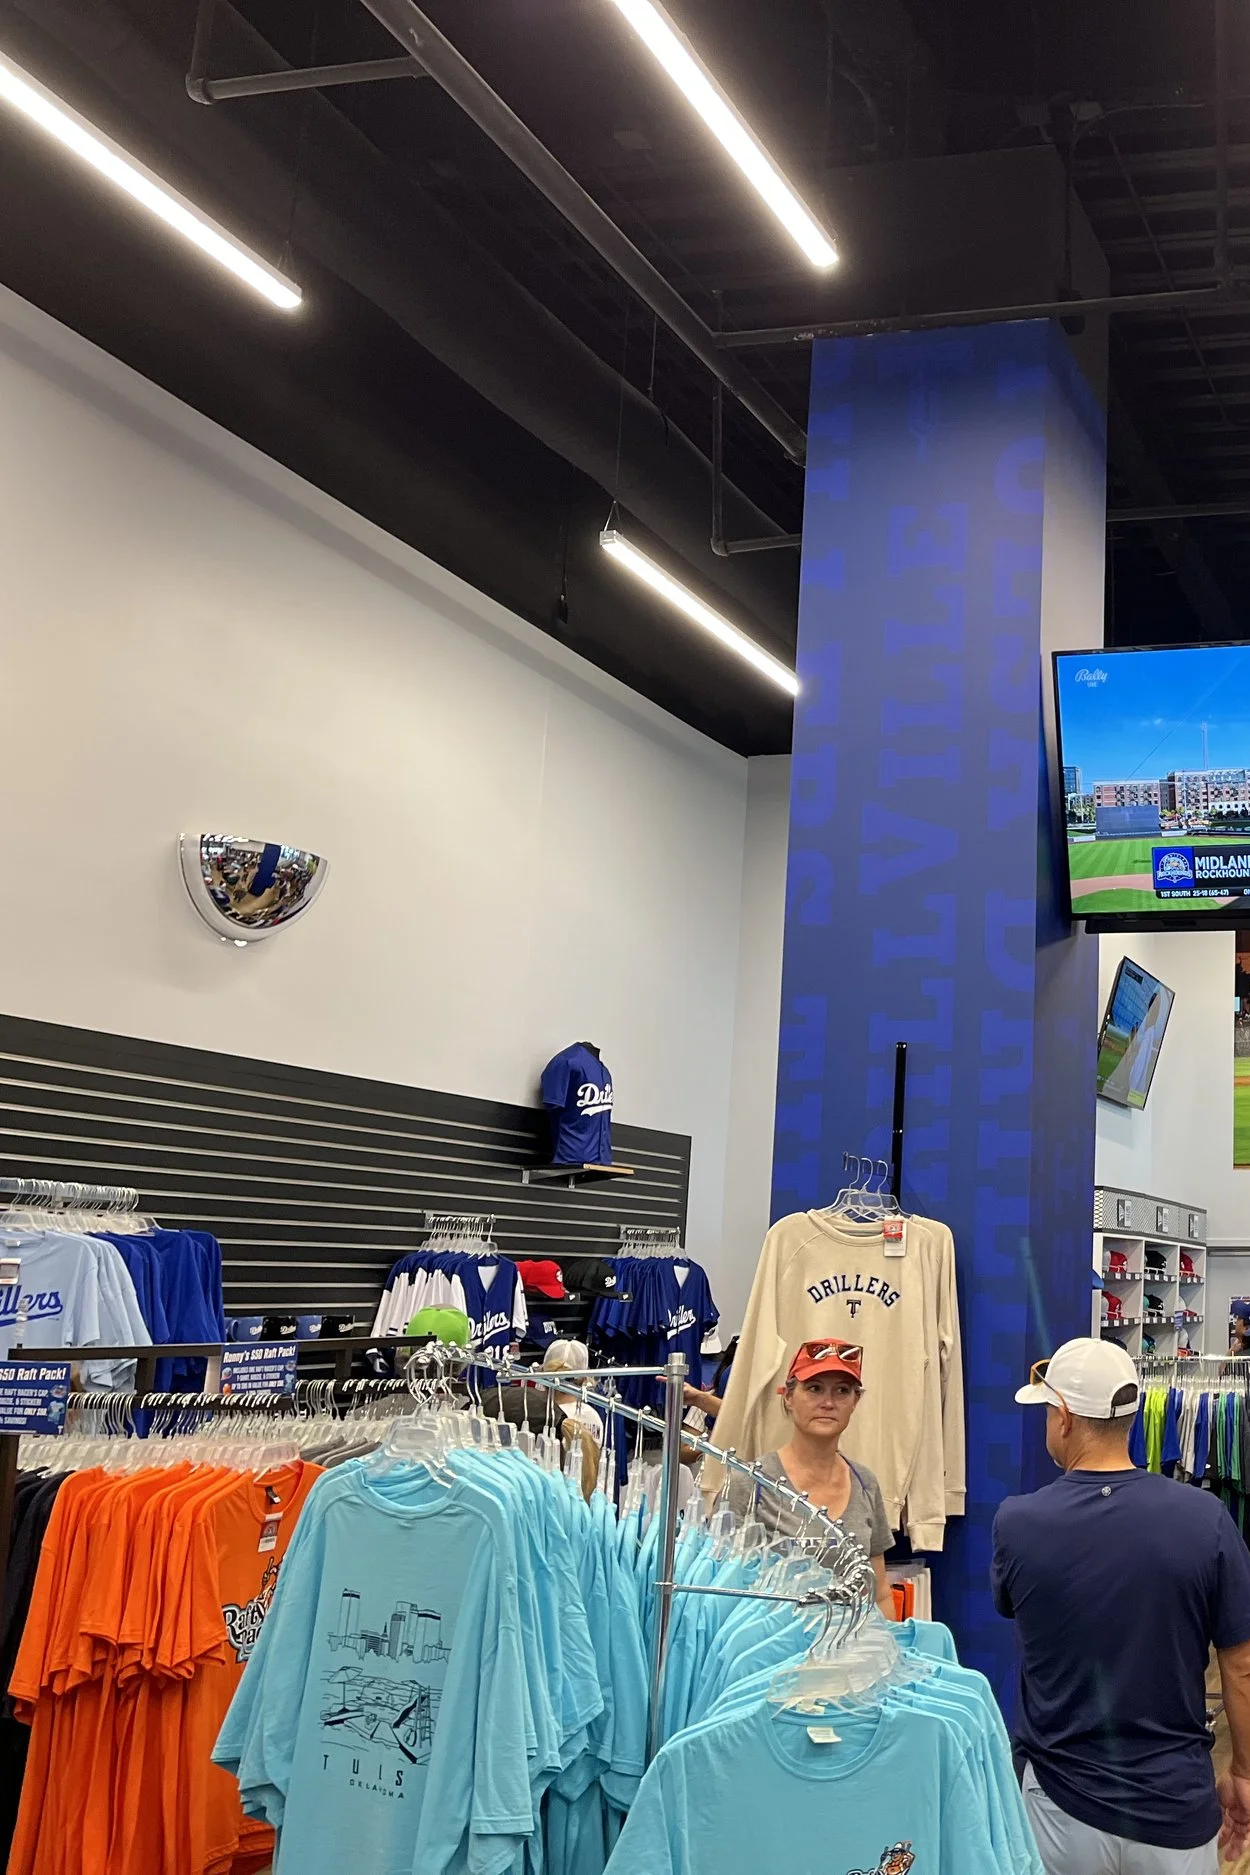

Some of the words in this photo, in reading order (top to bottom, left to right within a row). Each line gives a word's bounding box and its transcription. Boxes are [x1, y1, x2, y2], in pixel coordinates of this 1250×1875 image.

[1074, 668, 1108, 683] Bally
[807, 1274, 901, 1307] DRILLERS
[223, 1350, 251, 1364] Ronny's
[263, 1348, 277, 1359] Raft
[277, 1345, 296, 1357] Pack!
[17, 1368, 37, 1380] Raft
[39, 1367, 67, 1380] Pack!
[323, 1754, 404, 1786] TULS
